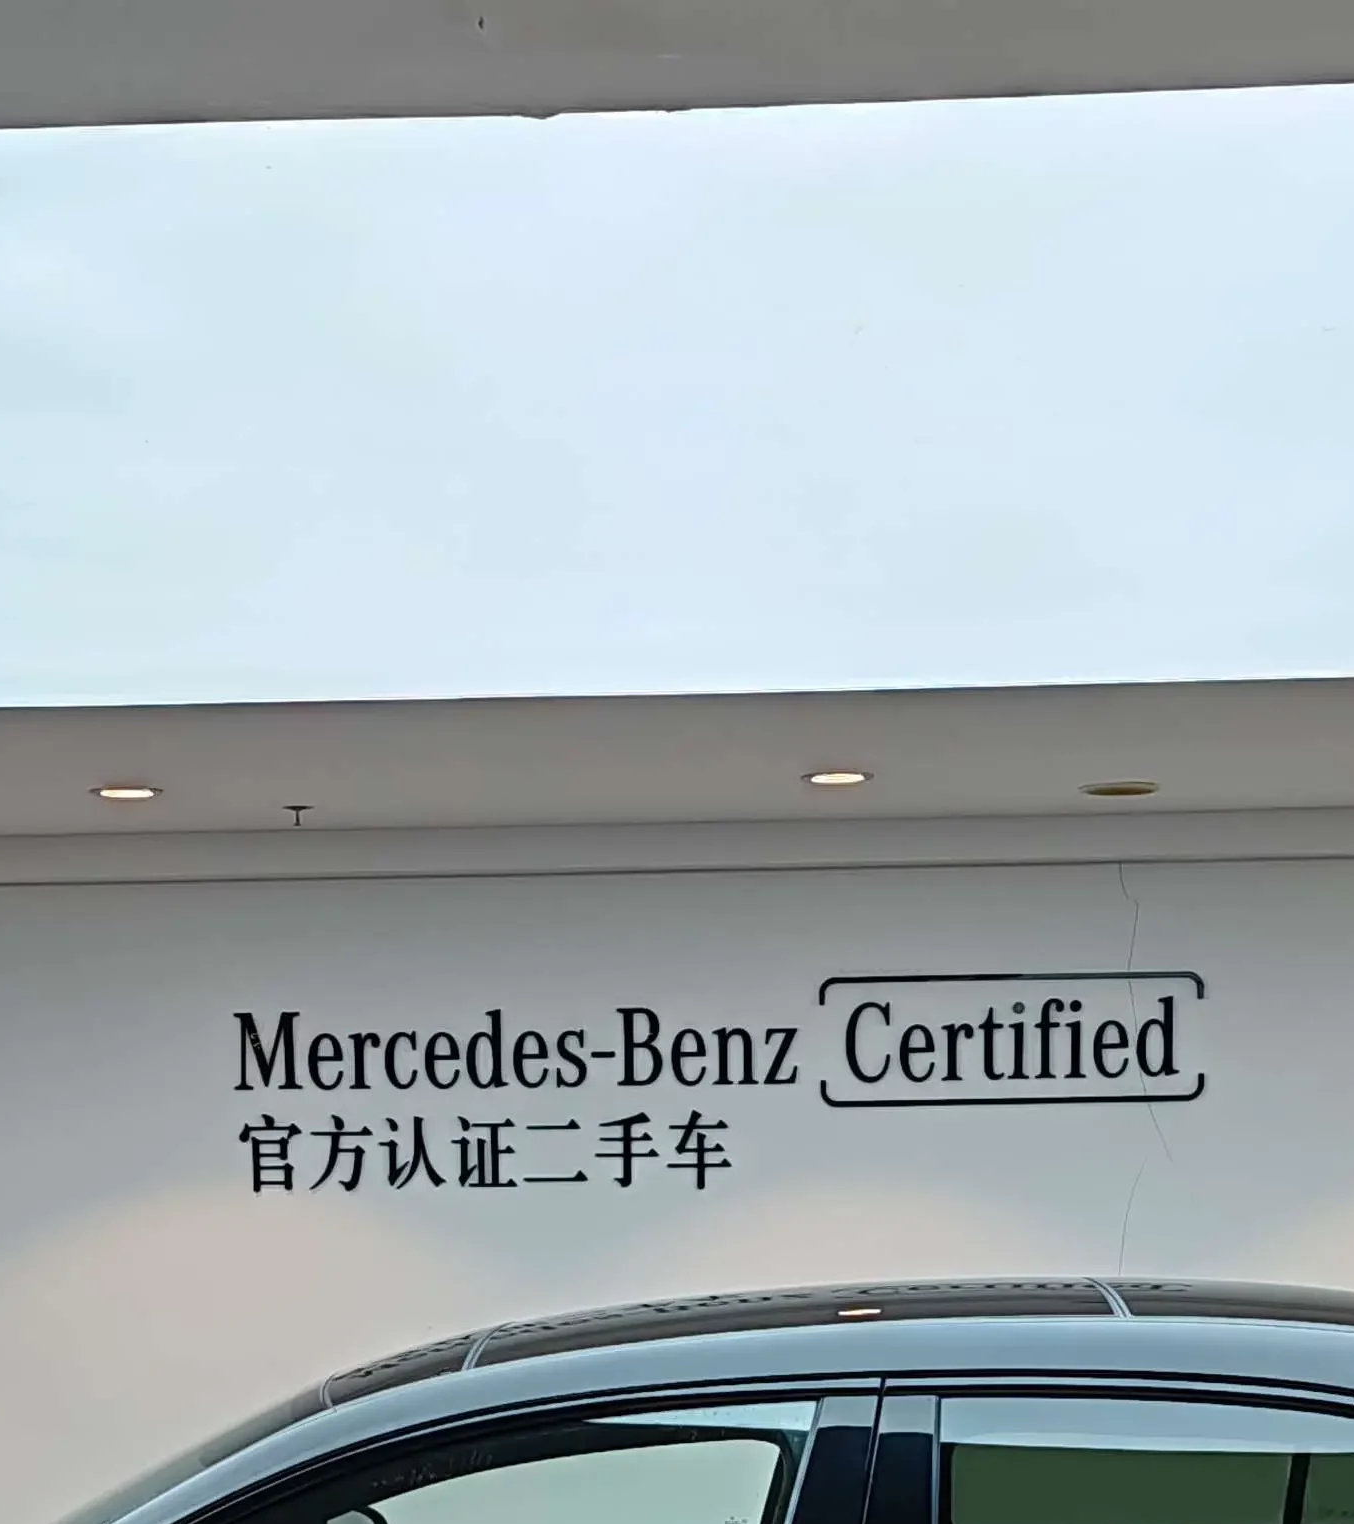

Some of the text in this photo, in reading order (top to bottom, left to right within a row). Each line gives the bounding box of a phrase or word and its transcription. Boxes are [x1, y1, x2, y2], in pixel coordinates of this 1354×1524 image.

[233, 996, 1179, 1091] Mercedes-Benz Certified
[239, 1111, 732, 1193] 官方认证二手车
